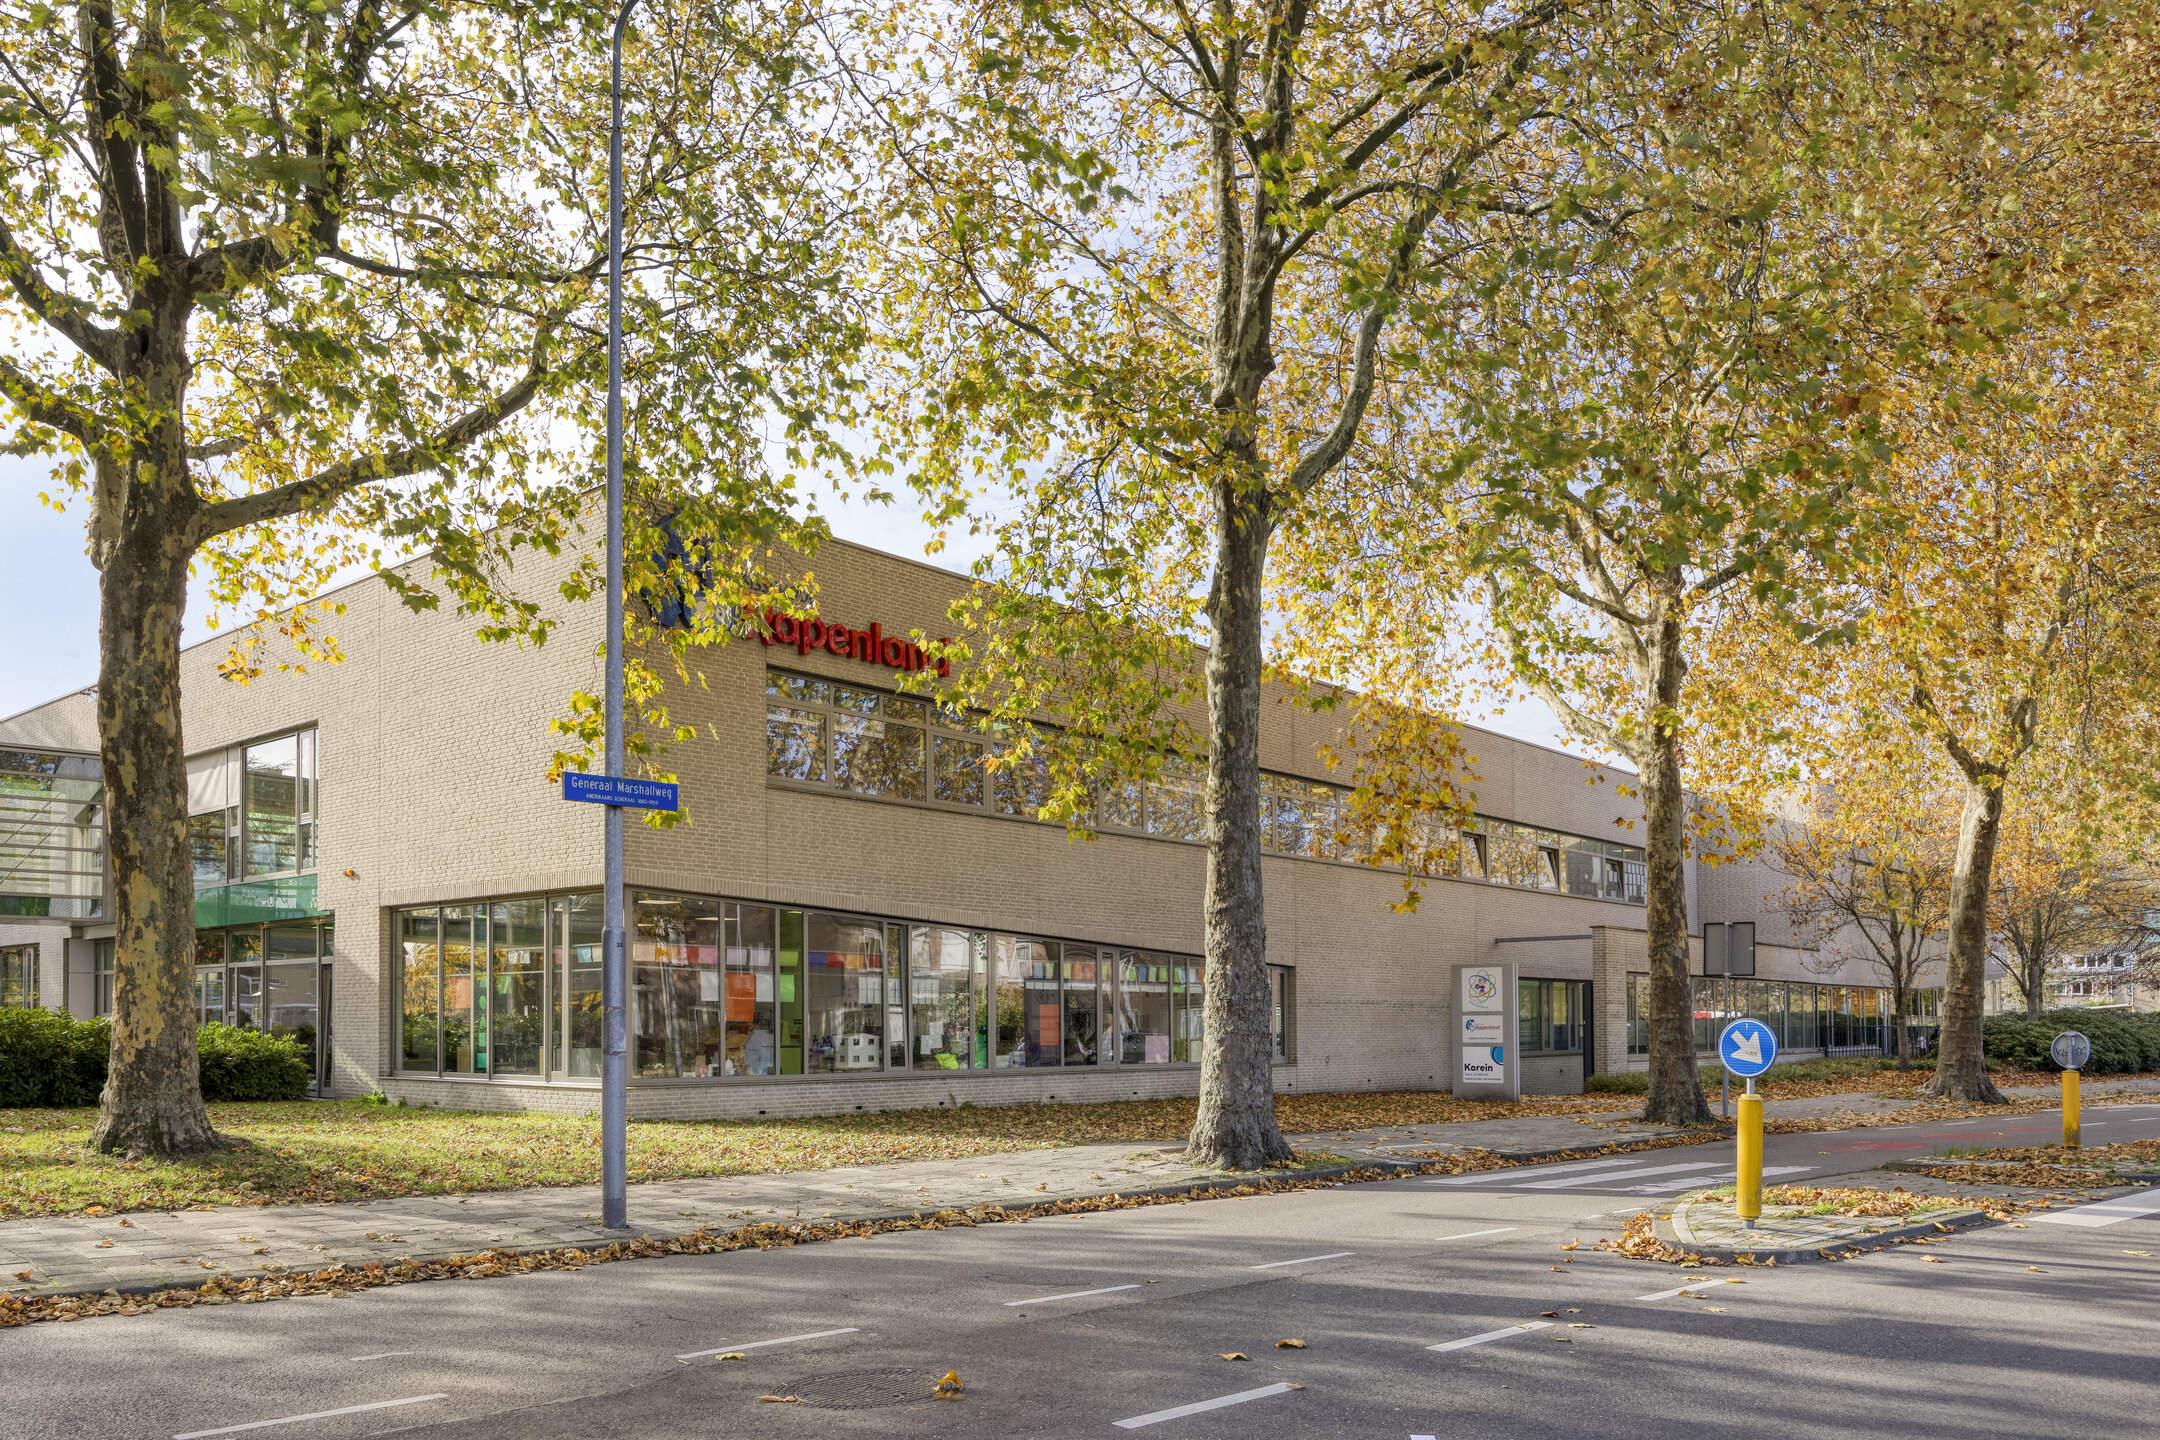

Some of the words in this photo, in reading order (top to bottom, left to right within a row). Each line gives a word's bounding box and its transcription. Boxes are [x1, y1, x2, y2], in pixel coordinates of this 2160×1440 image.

[571, 776, 613, 791] Generaal
[617, 781, 672, 800] Marshallweg
[1464, 1063, 1493, 1071] Korein
